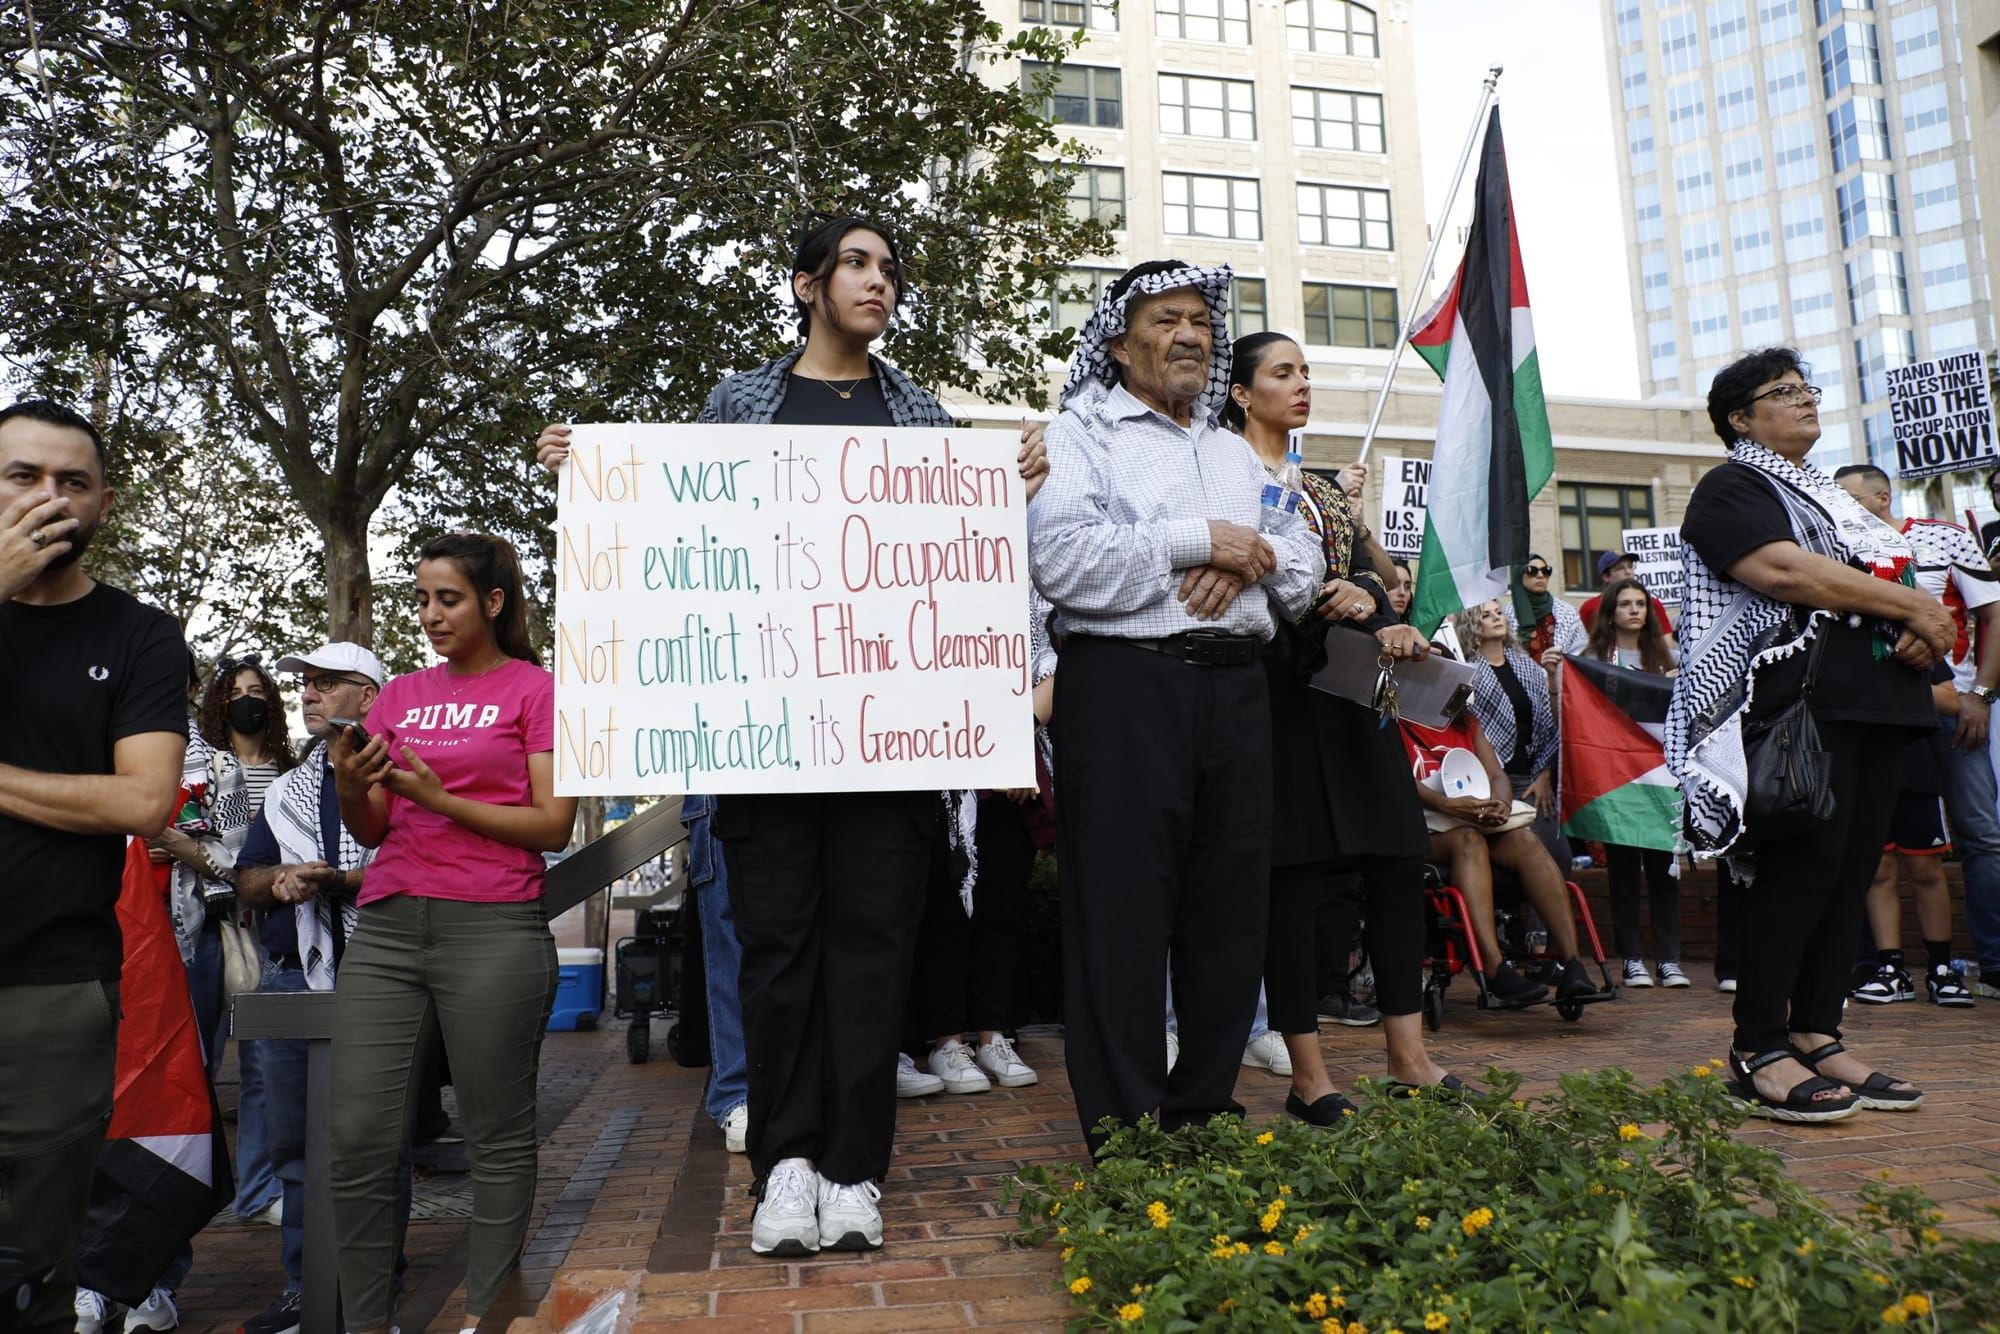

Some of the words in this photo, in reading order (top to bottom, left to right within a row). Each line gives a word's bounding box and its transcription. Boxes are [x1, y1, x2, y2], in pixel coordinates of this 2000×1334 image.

[1886, 362, 1934, 386] STAND
[1939, 352, 1981, 374] WITH
[1888, 368, 1984, 402] PALESTINE!
[1891, 395, 1937, 424] END
[1942, 385, 1988, 413] THE
[1893, 409, 1991, 440] OCCUPATION
[1896, 424, 1994, 470] NOW!
[569, 443, 648, 503] Not
[662, 459, 760, 510] war,
[773, 439, 821, 503] it's
[1401, 460, 1432, 485] EN
[1386, 510, 1418, 532] U.S.
[1384, 532, 1399, 547] TO
[1626, 534, 1660, 551] FREE
[562, 521, 629, 592] Not
[643, 524, 760, 594] eviction,
[774, 521, 822, 591] it's
[841, 514, 1015, 609] Occupation
[559, 618, 625, 686] Not
[638, 613, 748, 686] conflict,
[758, 612, 798, 678] it's
[813, 602, 897, 678] Ethnic
[909, 600, 1027, 696] Cleansing
[395, 703, 500, 729] PUMA
[403, 736, 434, 746] SINCE
[559, 706, 618, 780] Not
[635, 697, 801, 790] complicated,
[810, 699, 844, 767] it's
[860, 695, 995, 764] Genocide
